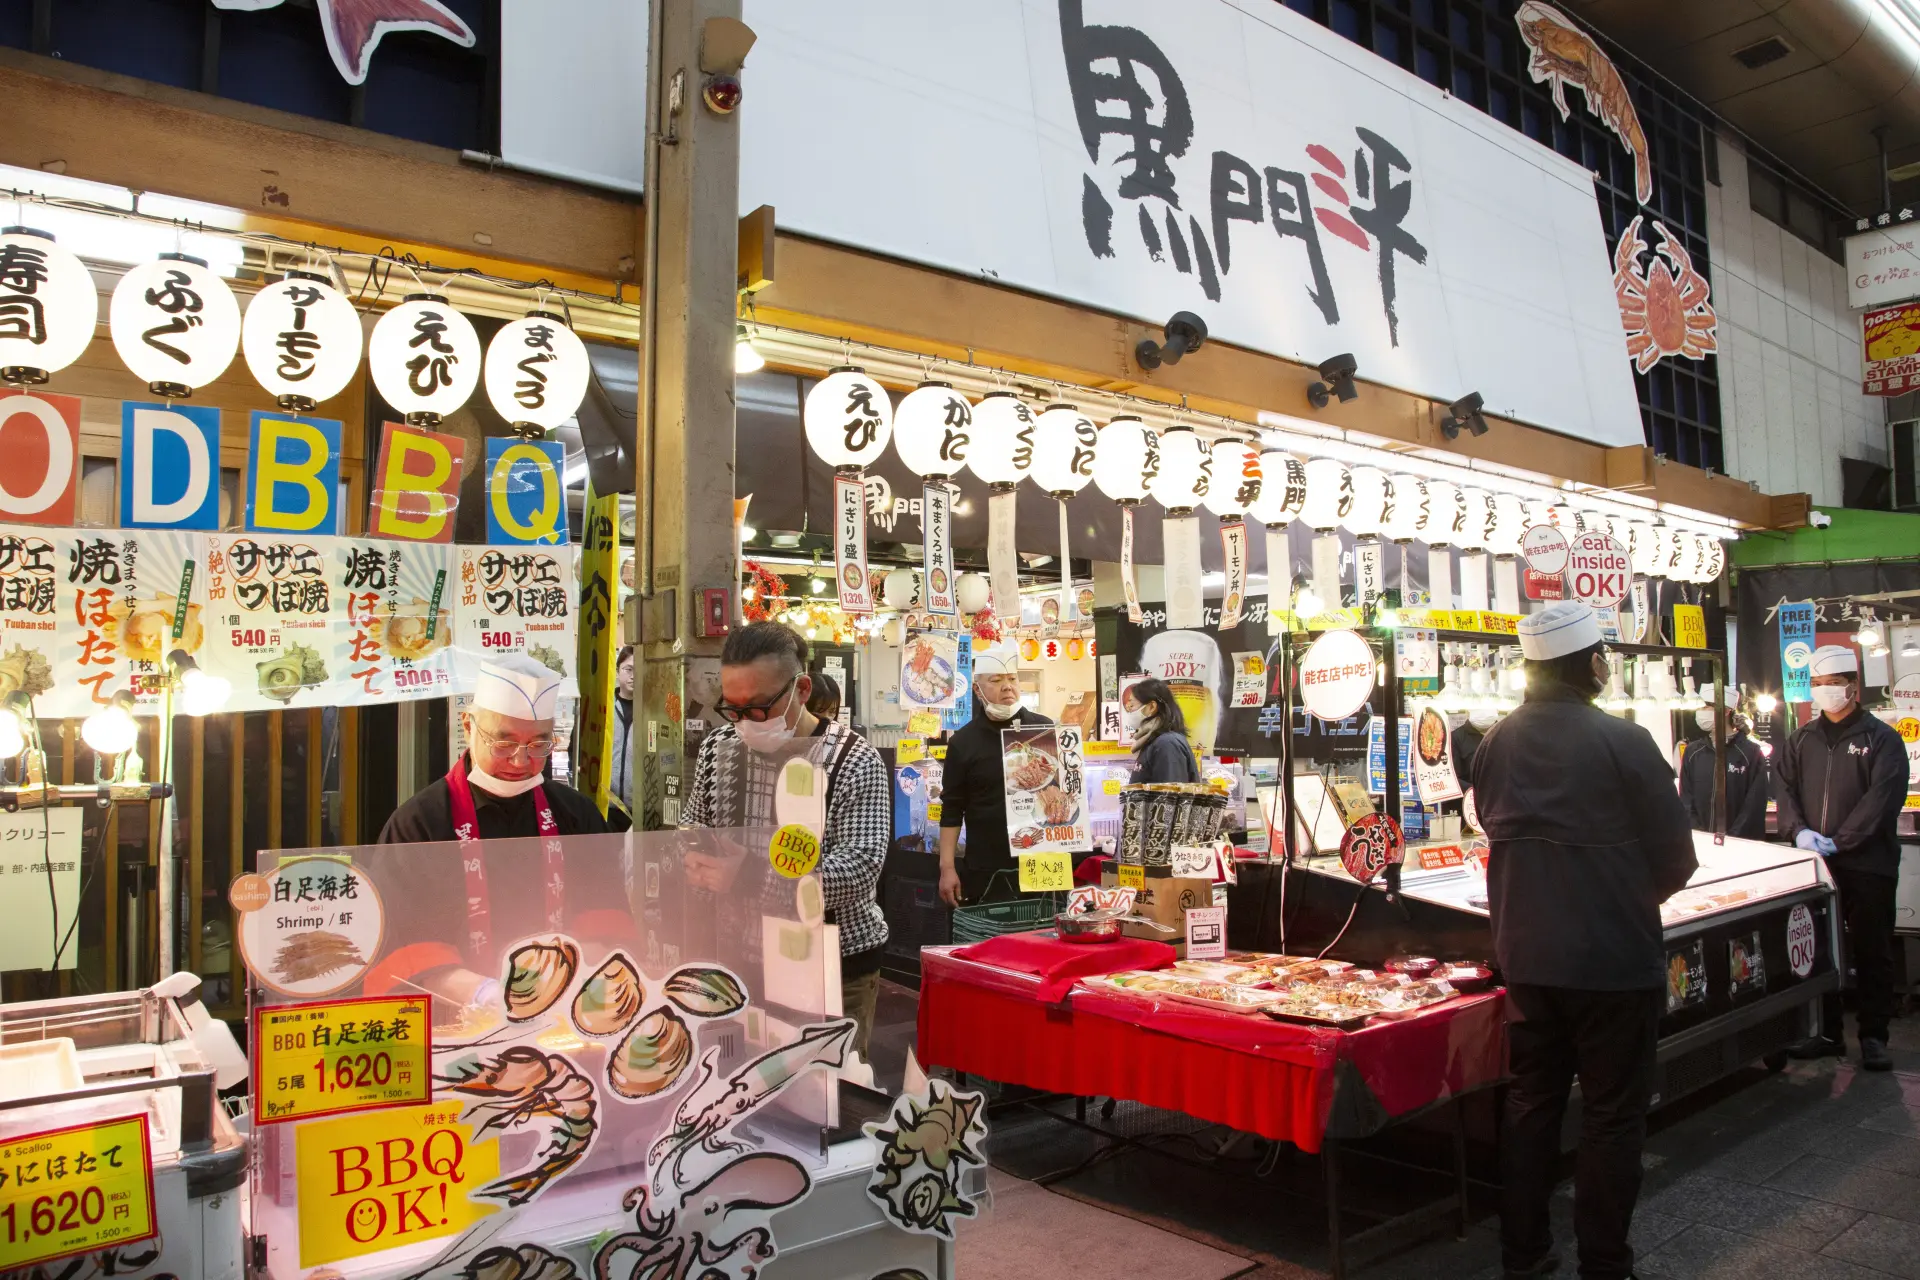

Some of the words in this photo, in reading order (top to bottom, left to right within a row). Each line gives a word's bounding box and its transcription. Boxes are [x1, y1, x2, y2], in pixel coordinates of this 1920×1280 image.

[143, 270, 203, 365] ふぐ
[276, 286, 326, 382] サーモン
[406, 310, 460, 397] えび
[512, 325, 559, 410] まぐろ
[844, 384, 882, 451] えび
[940, 396, 972, 461] かに
[1012, 403, 1036, 469] まぐろ
[1071, 418, 1098, 476] うに
[1141, 429, 1160, 490] ほたて
[1192, 438, 1213, 496] いくら
[1280, 459, 1306, 514] 黒門
[1379, 476, 1396, 523] かに
[845, 489, 857, 560] にぎり盛
[932, 497, 943, 567] 本まぐろ丼
[1483, 495, 1497, 541] ほたて
[230, 541, 322, 577] サザエ
[1229, 532, 1240, 591] サーモン丼
[1526, 541, 1567, 556] 能在店中吃!
[1572, 553, 1626, 570] inside
[1583, 536, 1612, 551] eat
[208, 551, 226, 600] 絶品
[461, 561, 476, 607] 絶品
[481, 552, 560, 585] サザエ
[1363, 551, 1375, 601] にぎり盛
[1576, 573, 1624, 598] OK!
[1782, 609, 1811, 622] FREE
[1782, 623, 1811, 635] Wi-Fi
[1236, 679, 1264, 688] 生ビール
[1305, 662, 1372, 686] 能在店中吃!
[1058, 730, 1081, 795] かに鍋
[775, 852, 806, 876] OK!
[778, 830, 816, 862] BBQ
[274, 874, 359, 903] 白足海老
[277, 915, 323, 929] Shrimp
[339, 912, 353, 925] 虾
[1788, 922, 1812, 943] inside
[1793, 905, 1806, 921] eat
[1791, 942, 1813, 970] OK!
[273, 1033, 305, 1051] BBQ
[312, 1017, 411, 1047] 白足海老
[277, 1075, 305, 1090] 5尾
[15, 1142, 53, 1156] Scallop
[329, 1129, 465, 1197] BBQ
[345, 1182, 448, 1243] OK!
